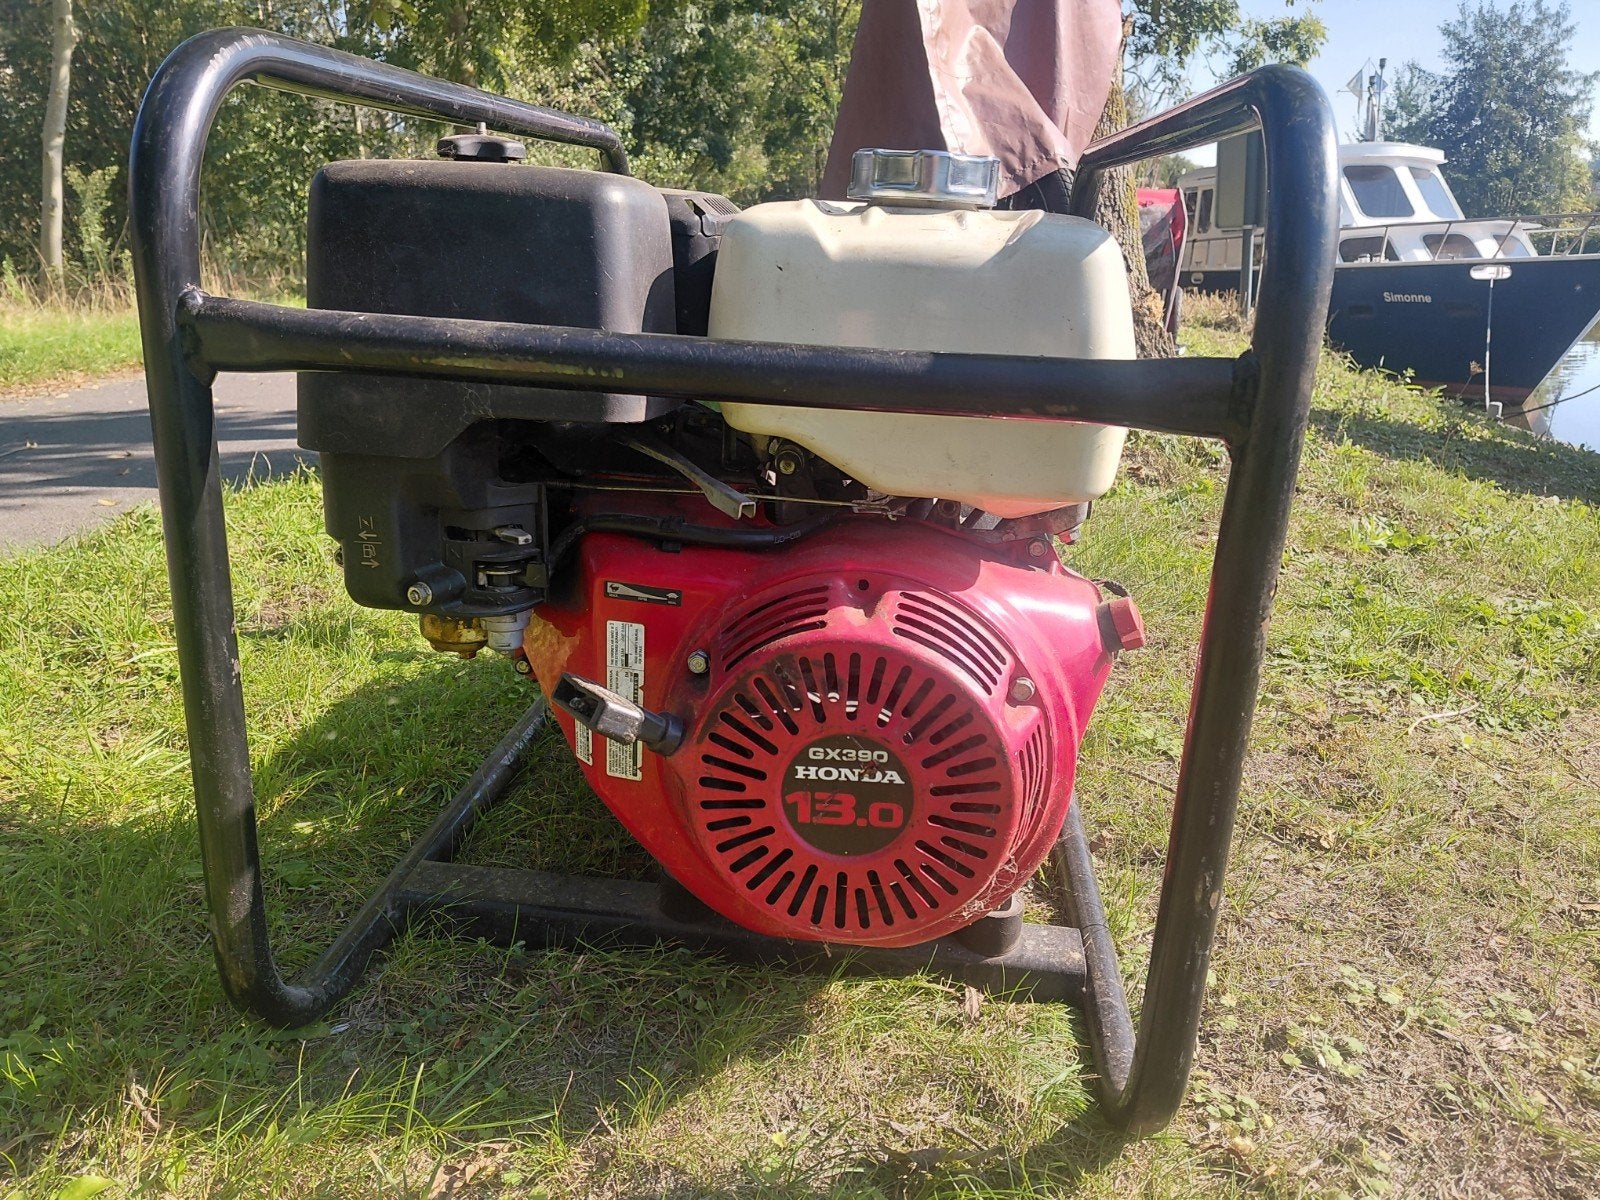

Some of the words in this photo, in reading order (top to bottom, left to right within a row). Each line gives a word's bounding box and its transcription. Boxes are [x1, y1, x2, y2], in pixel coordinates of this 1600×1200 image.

[1383, 291, 1432, 303] Simonne
[808, 747, 889, 763] GX390
[795, 765, 906, 785] HONDA
[785, 791, 904, 828] 13.0
